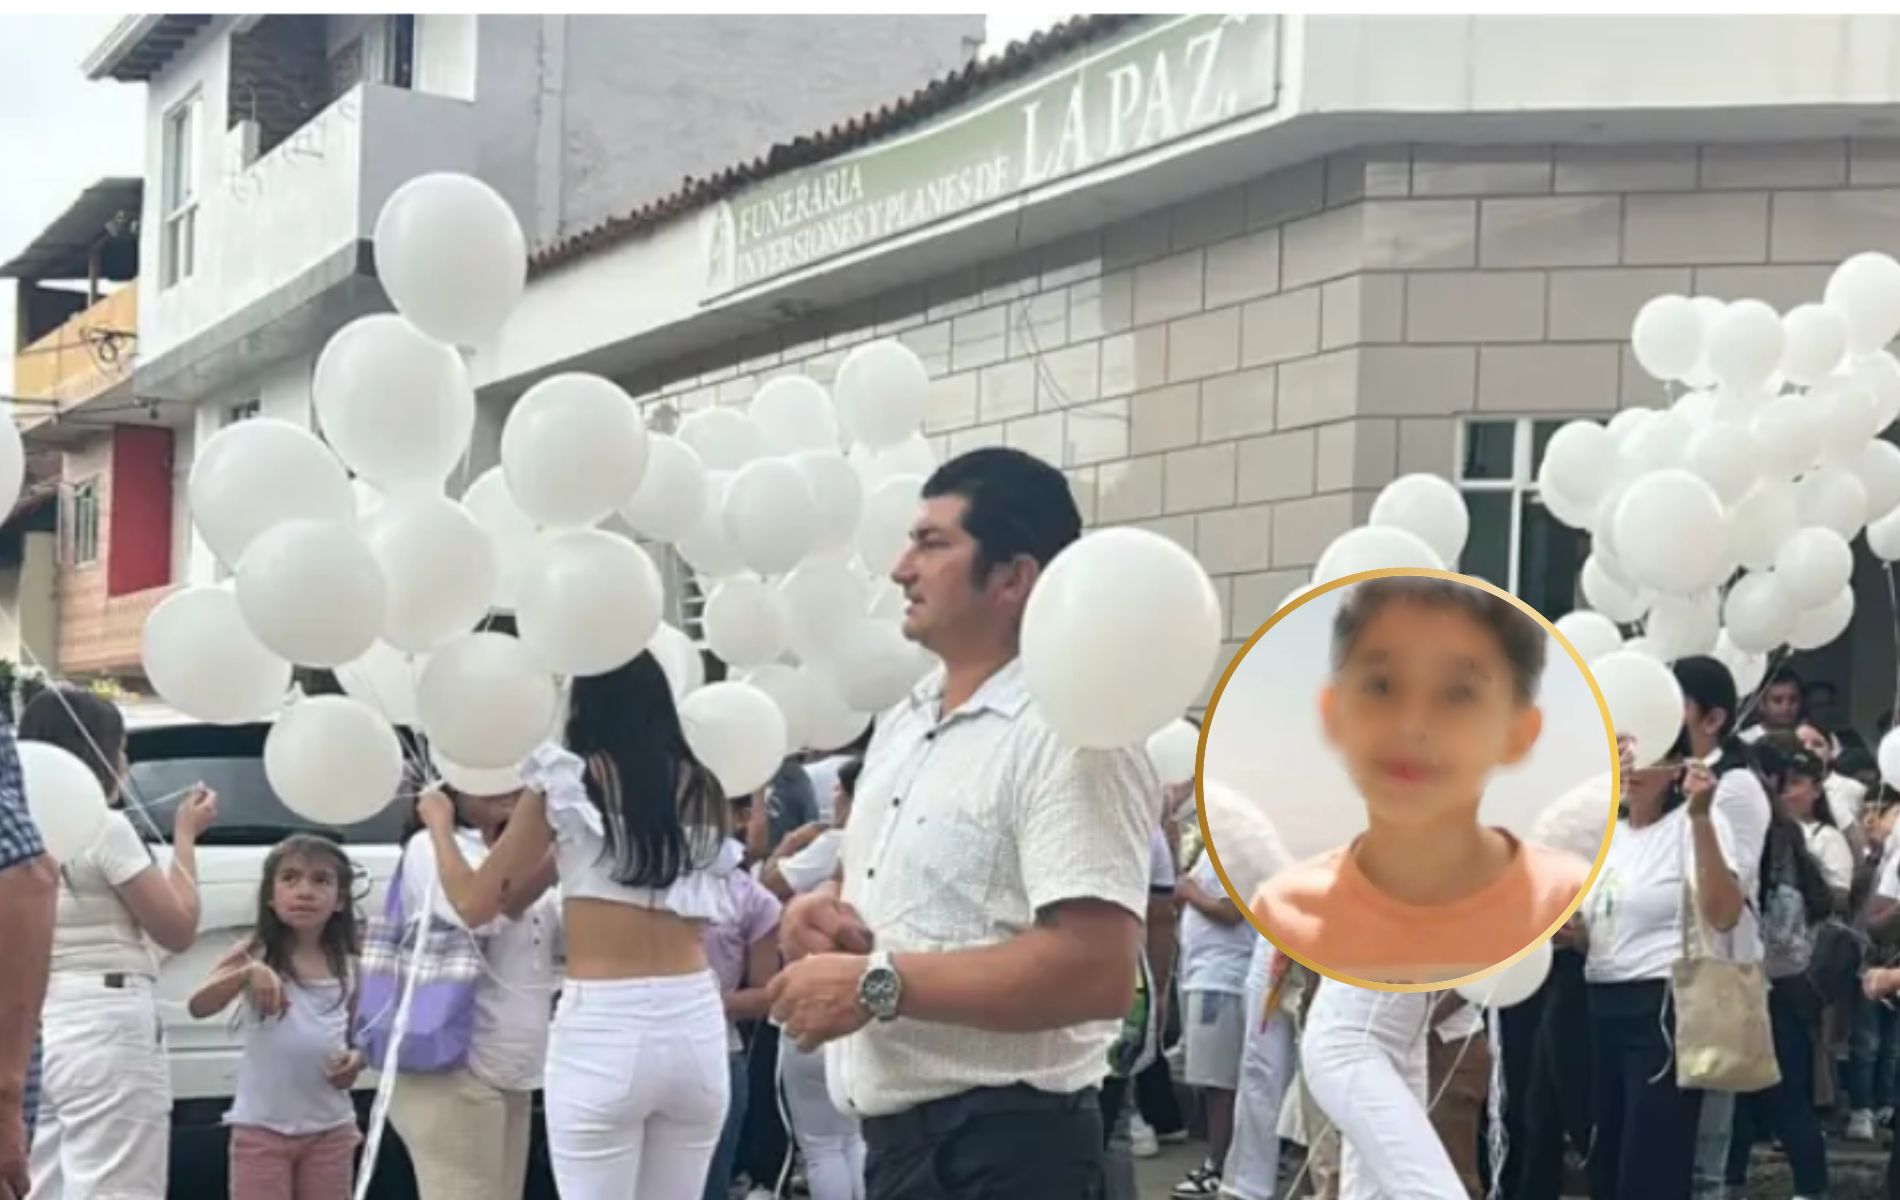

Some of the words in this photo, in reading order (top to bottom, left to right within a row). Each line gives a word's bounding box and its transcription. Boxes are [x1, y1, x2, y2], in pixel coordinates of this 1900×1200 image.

[737, 202, 864, 281] INVERSIONES
[866, 199, 885, 237] Y
[885, 168, 973, 233] PLANES
[975, 157, 1010, 200] DE
[1018, 83, 1092, 185] LA
[740, 164, 863, 246] FUNERARIA
